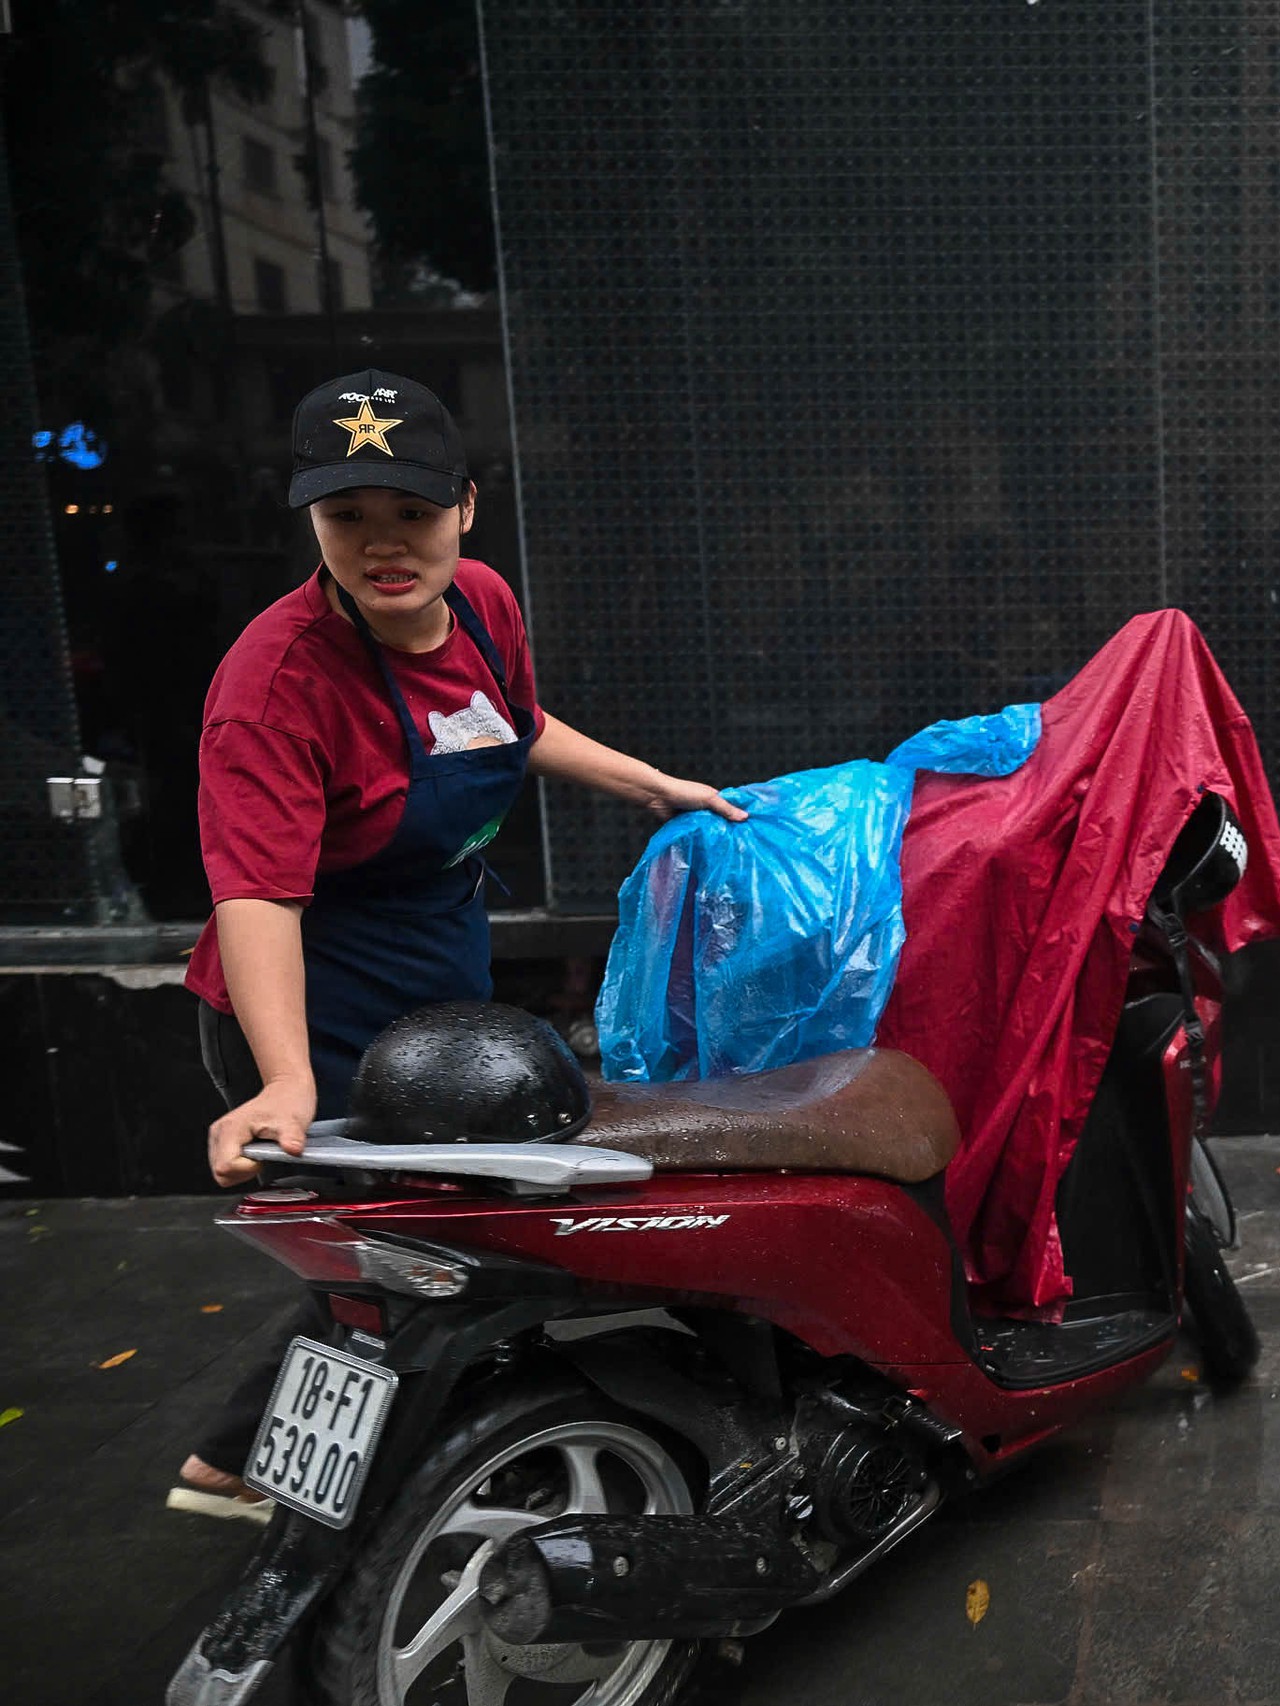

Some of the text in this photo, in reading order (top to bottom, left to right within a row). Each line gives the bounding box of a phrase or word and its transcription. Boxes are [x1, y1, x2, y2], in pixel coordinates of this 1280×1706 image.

[549, 1214, 732, 1236] VISION
[291, 1356, 374, 1440] 18-F1
[256, 1416, 359, 1513] 539.00
